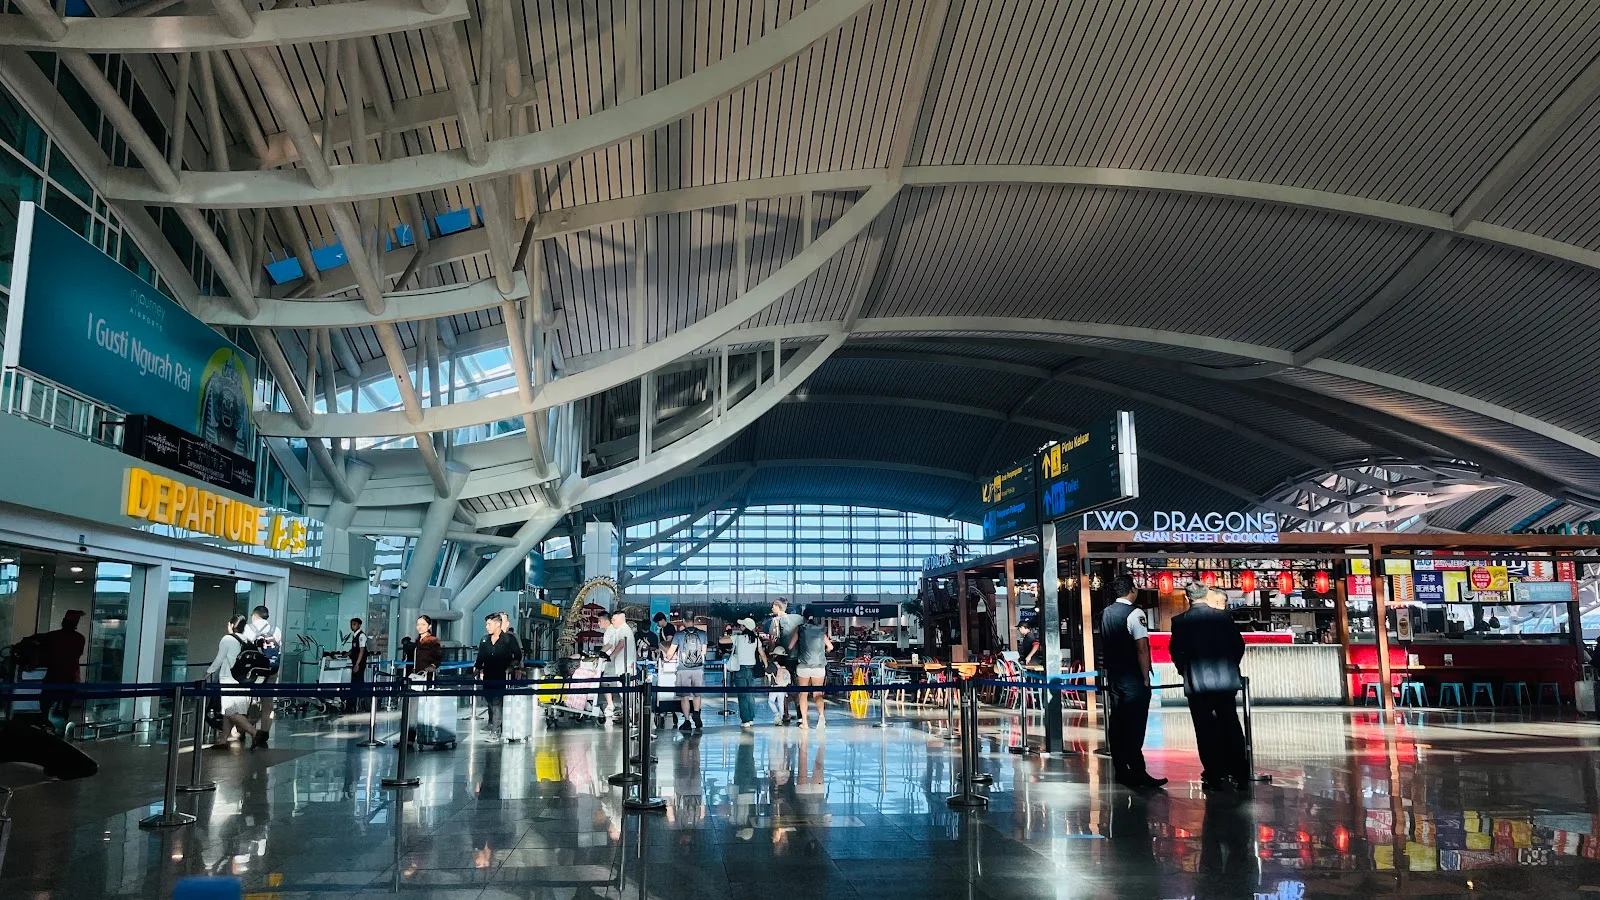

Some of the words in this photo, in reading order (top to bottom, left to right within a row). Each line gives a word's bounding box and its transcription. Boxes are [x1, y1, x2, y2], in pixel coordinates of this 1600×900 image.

[87, 311, 93, 340] I
[96, 318, 129, 359] Gusti
[130, 336, 172, 382] Ngurah
[174, 362, 192, 392] Rai
[127, 466, 268, 546] DEPARTURE
[1083, 510, 1139, 531] TWO
[1153, 510, 1278, 533] DRAGONS
[1132, 531, 1170, 542] ASIAN
[1172, 532, 1221, 543] STREET
[1221, 532, 1279, 544] COOKING
